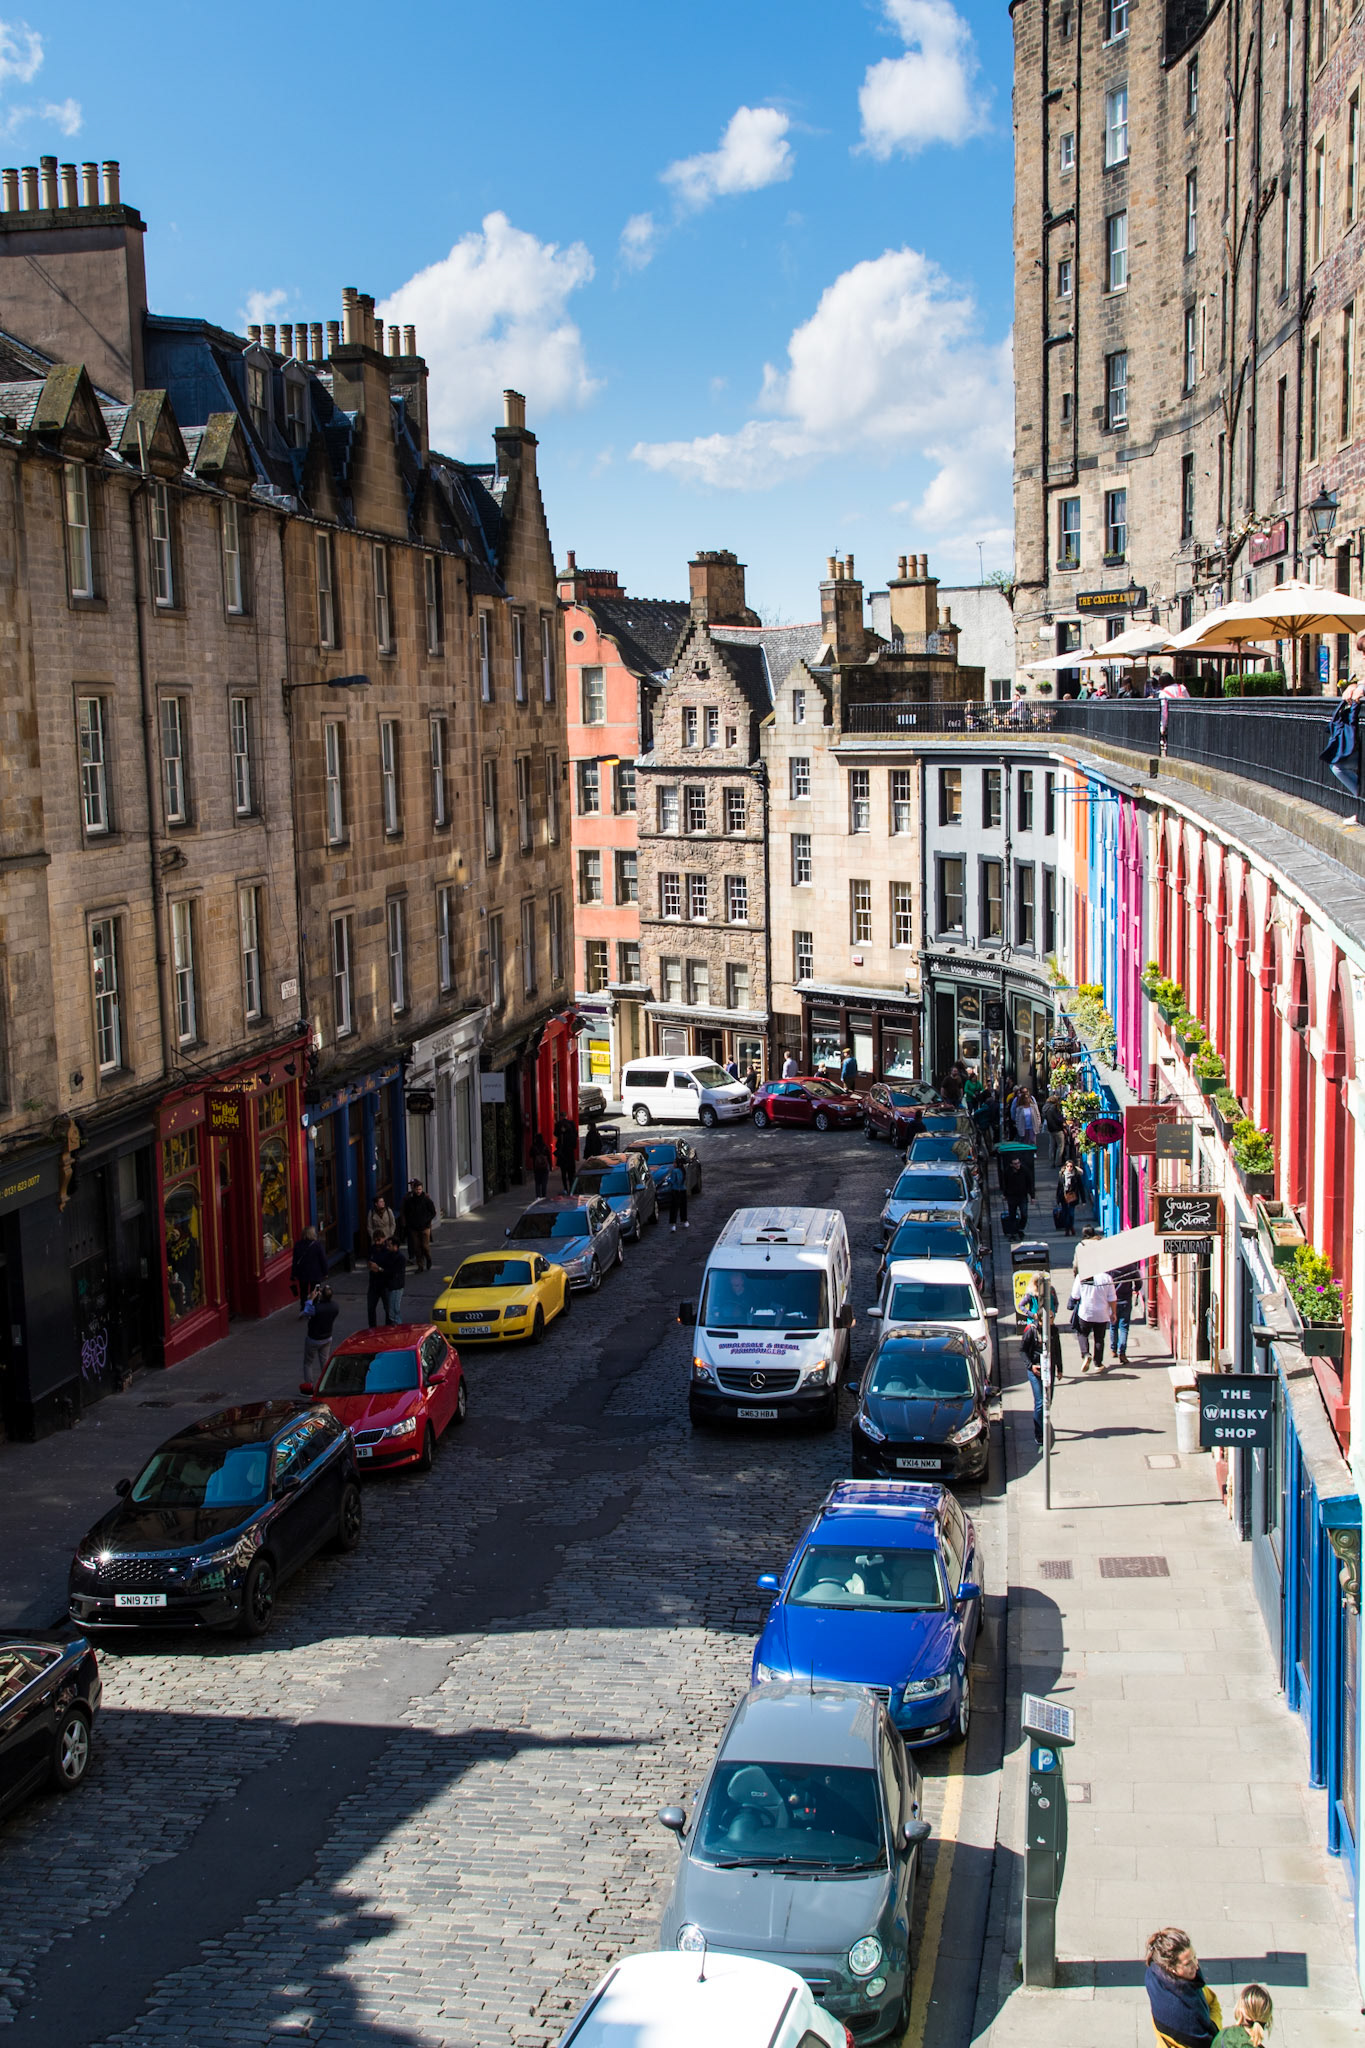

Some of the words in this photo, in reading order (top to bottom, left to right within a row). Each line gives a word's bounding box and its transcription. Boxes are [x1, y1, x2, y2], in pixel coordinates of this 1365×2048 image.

[1078, 597, 1091, 606] THE
[1093, 595, 1119, 604] CASTLE
[222, 1104, 238, 1116] Boy
[212, 1114, 240, 1125] Wizard
[1164, 1240, 1211, 1254] RESTAURANT
[1221, 1389, 1251, 1399] THE
[1203, 1404, 1267, 1421] WHISKY
[1215, 1428, 1256, 1438] SHOP
[121, 1596, 140, 1604] SN19
[143, 1596, 161, 1604] ZTF
